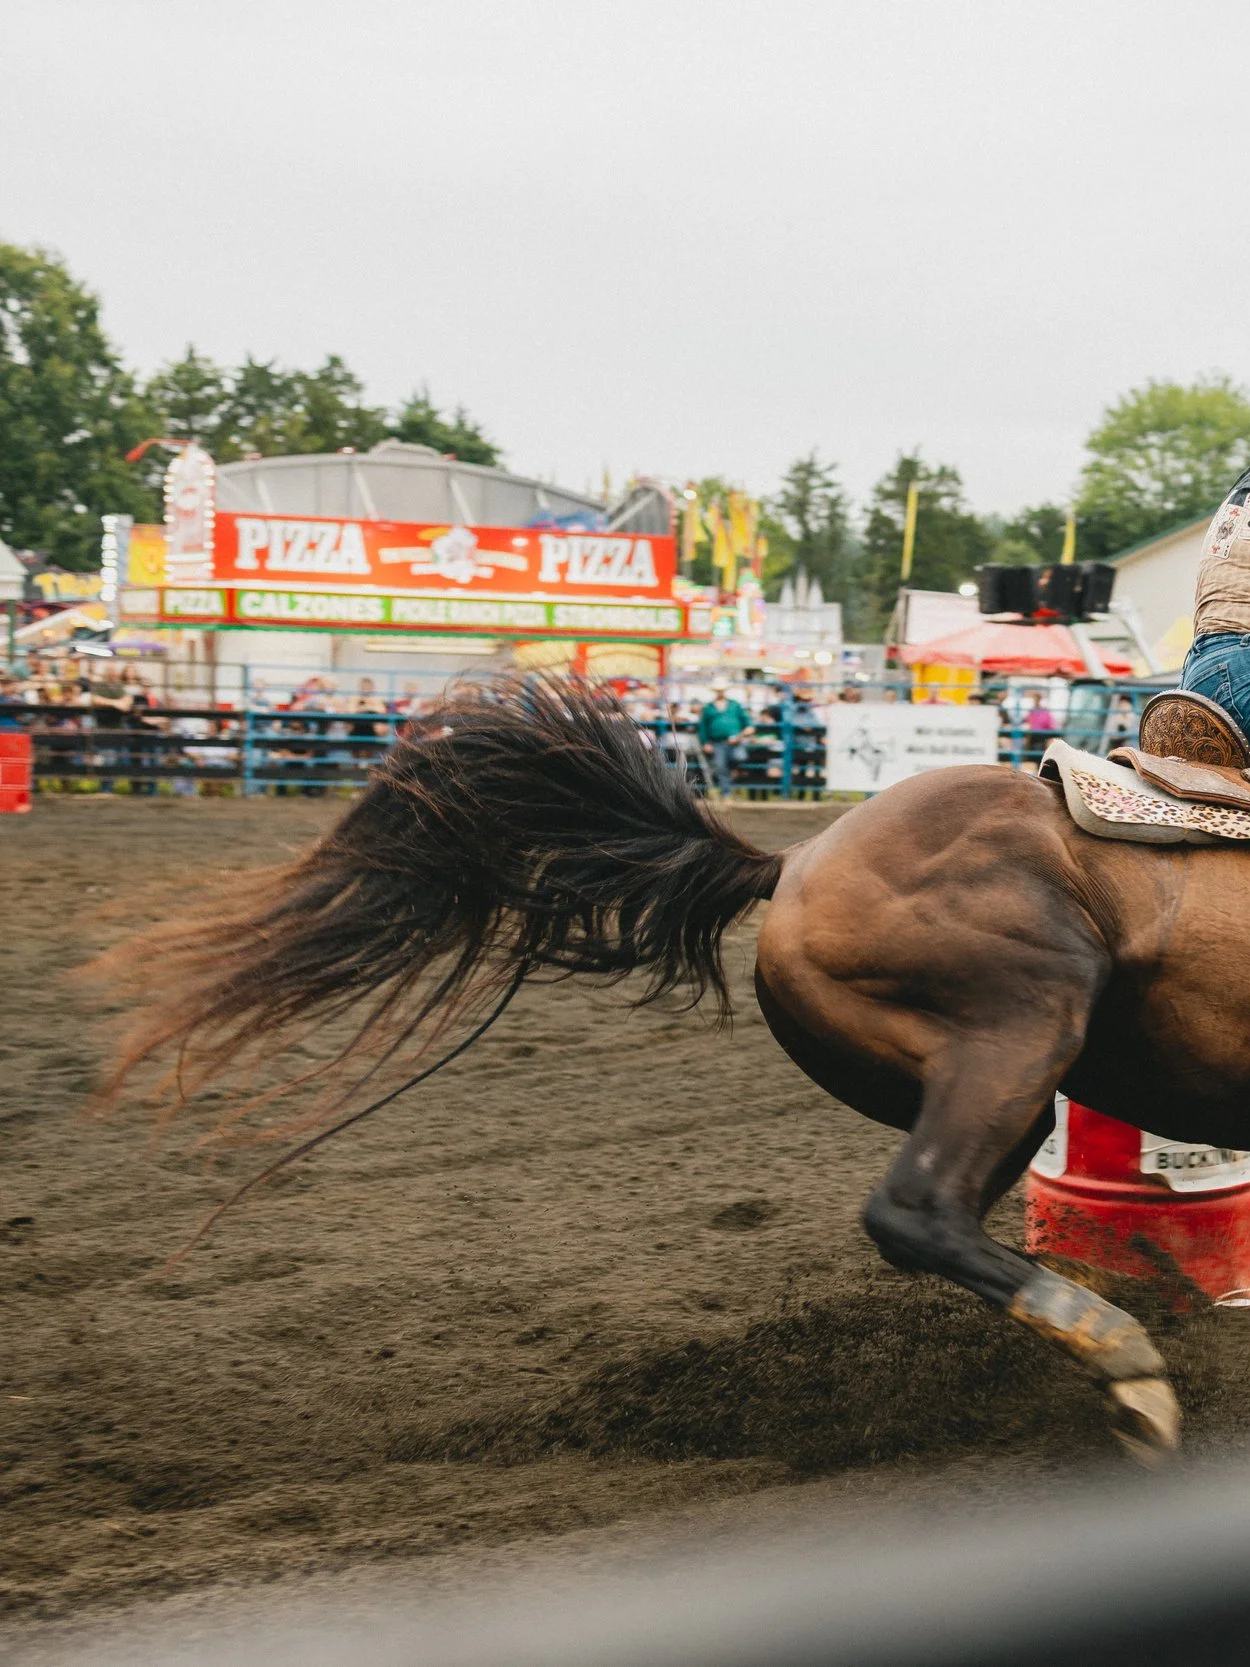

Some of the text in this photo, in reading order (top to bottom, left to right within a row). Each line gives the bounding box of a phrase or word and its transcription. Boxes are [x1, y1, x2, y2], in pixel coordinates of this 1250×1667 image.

[235, 518, 372, 574] PIZZA
[538, 534, 659, 587] PIZZA
[165, 591, 222, 614] PIZZA
[239, 590, 384, 621] CALZONES
